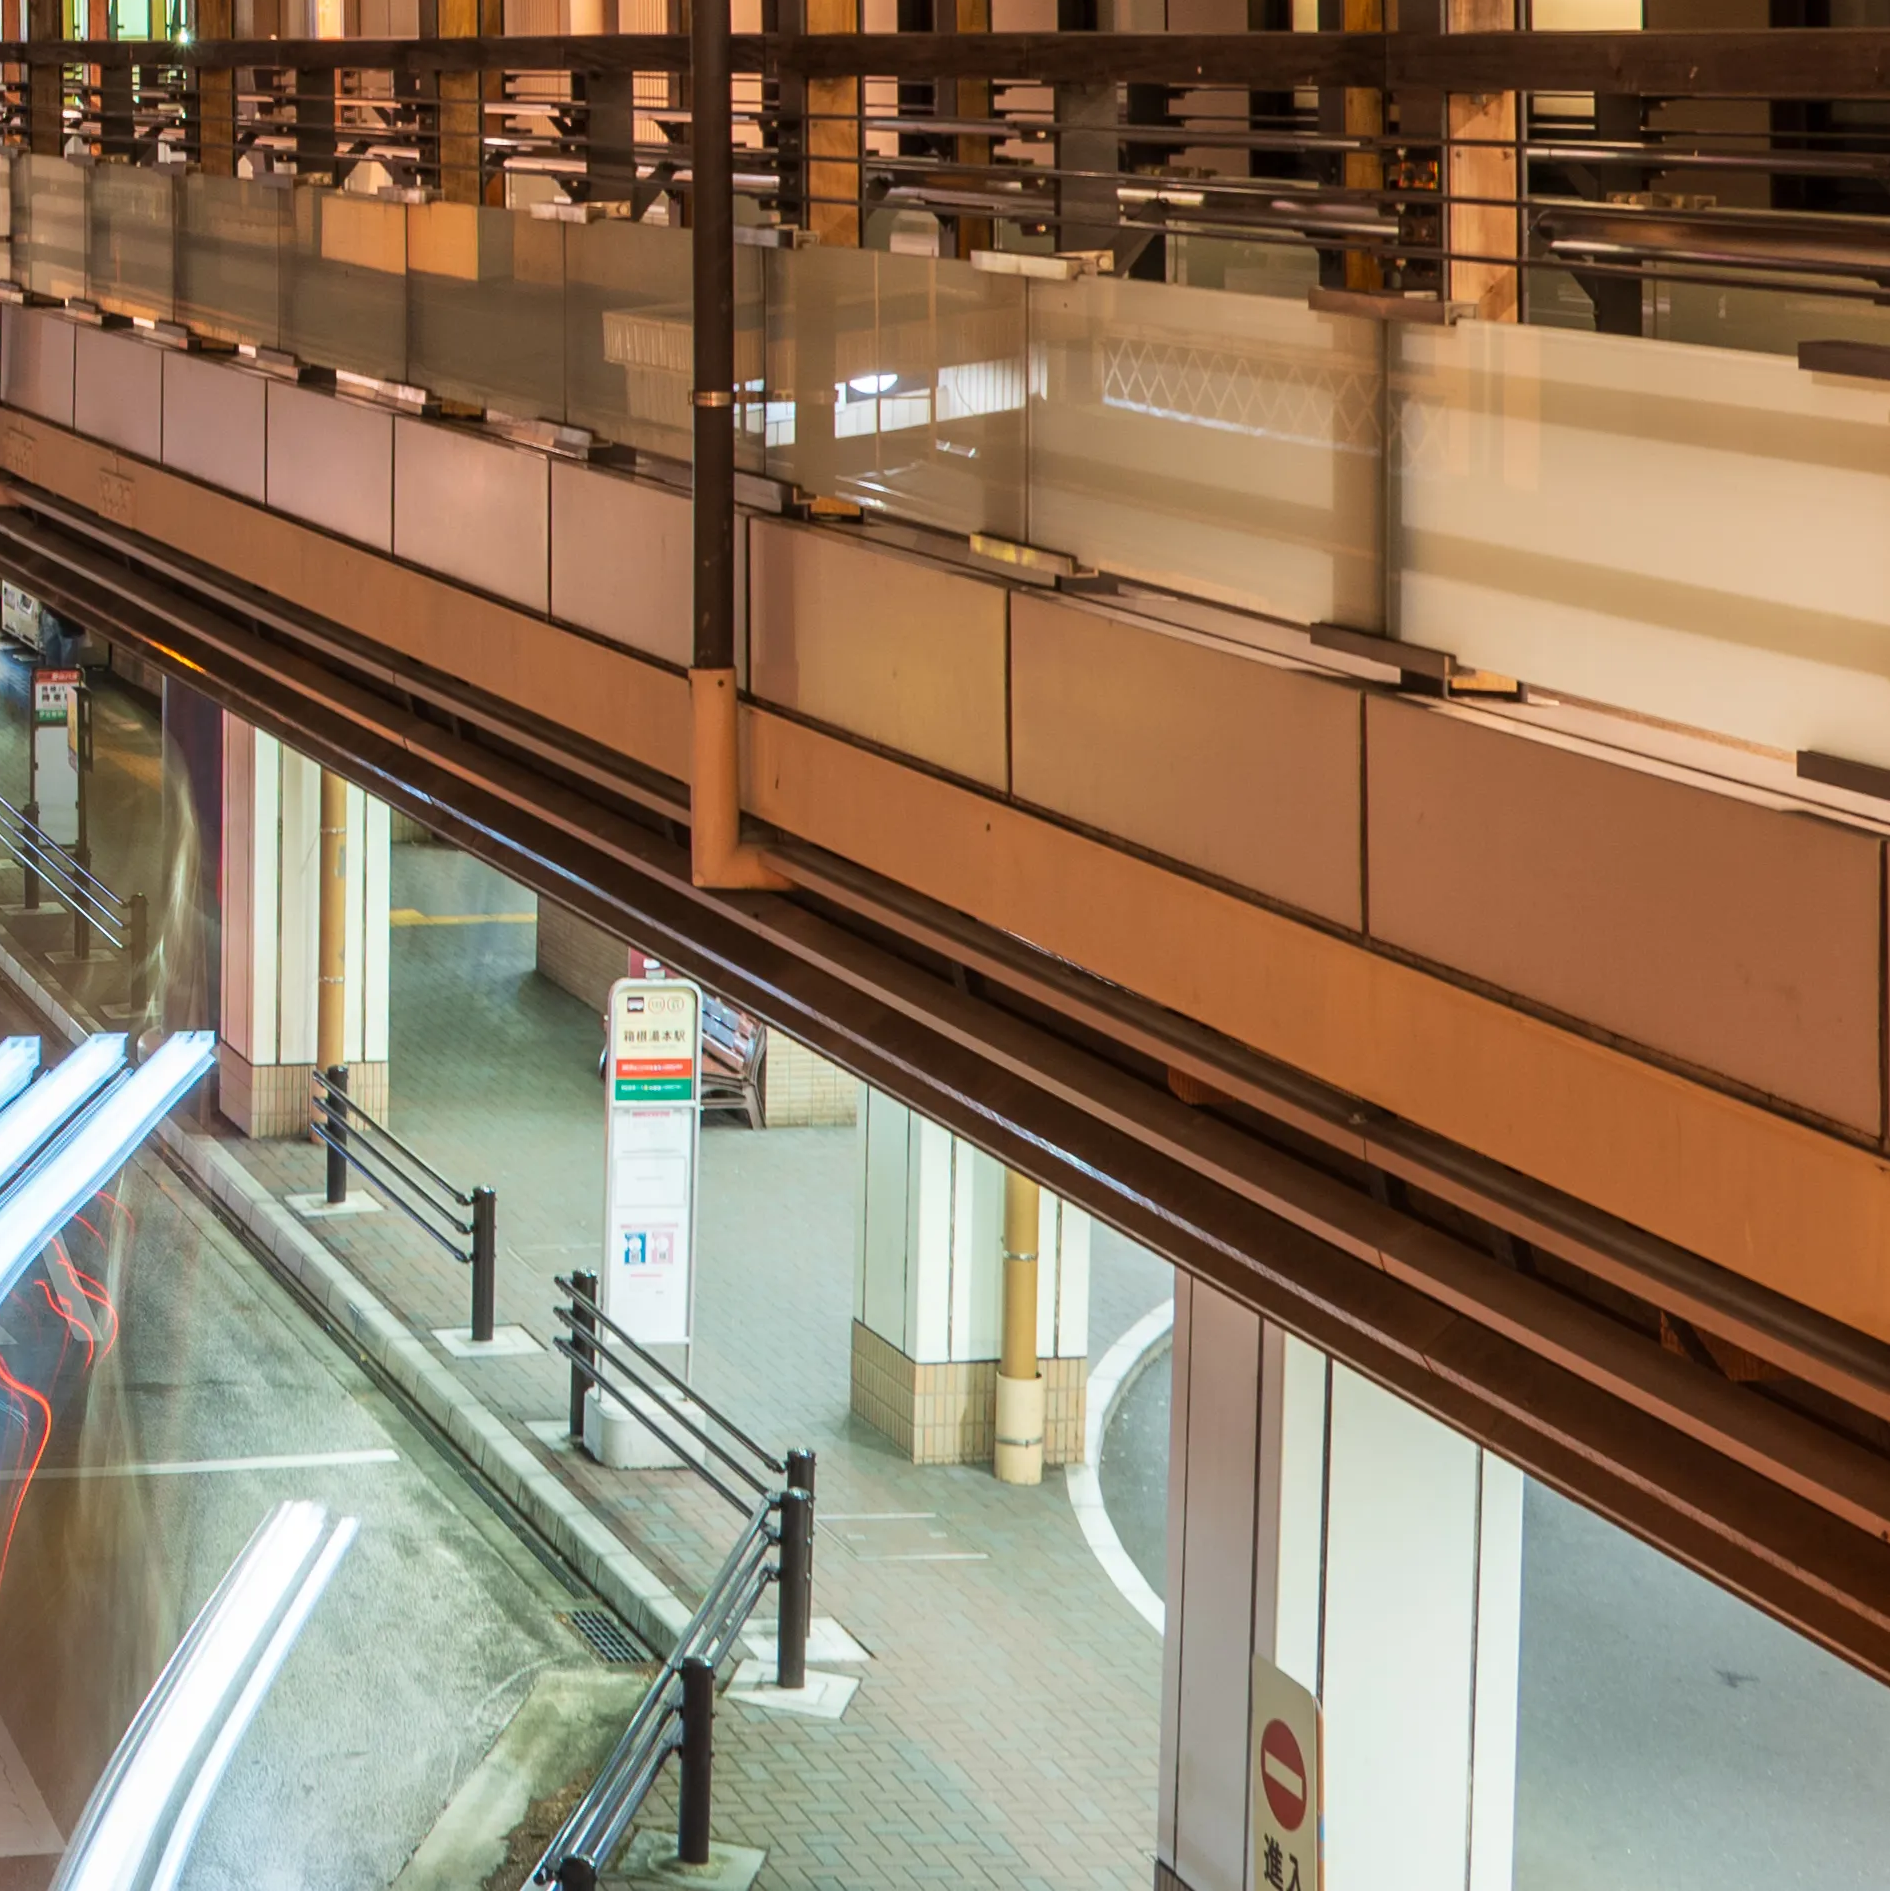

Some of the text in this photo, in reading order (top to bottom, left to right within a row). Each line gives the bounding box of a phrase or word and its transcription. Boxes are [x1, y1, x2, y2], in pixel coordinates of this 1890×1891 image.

[623, 1029, 687, 1043] 箱根湯本駅
